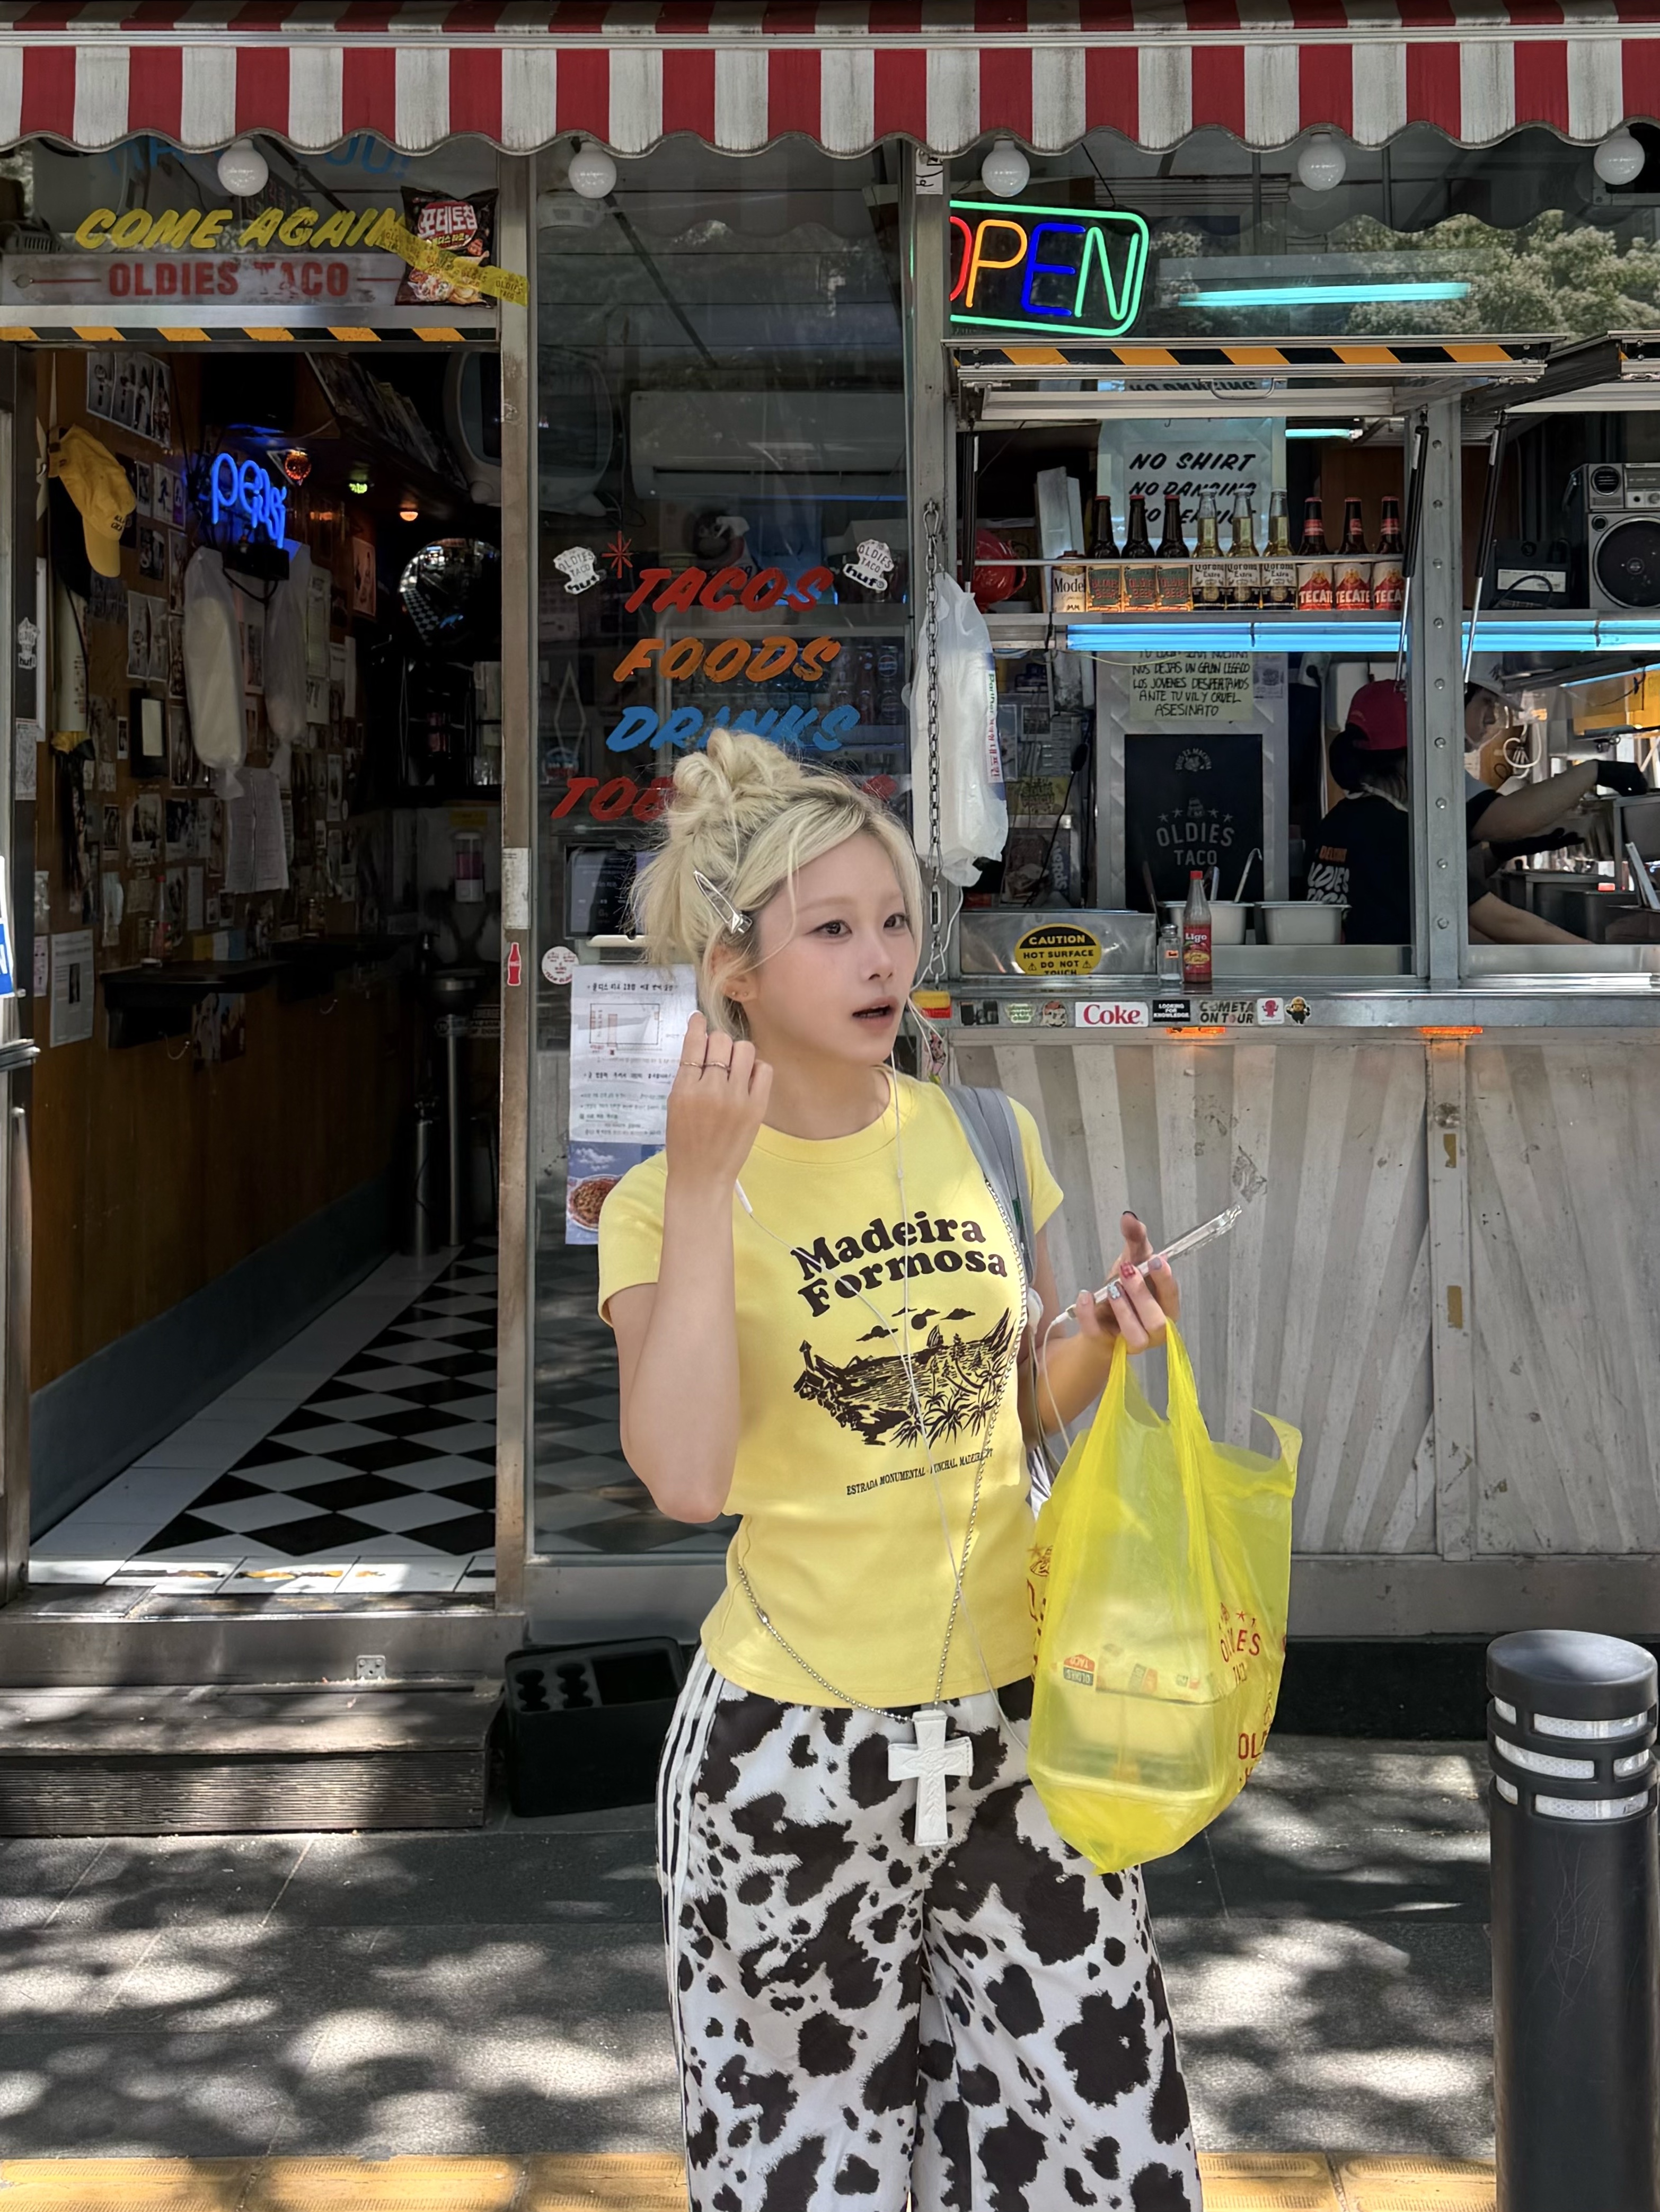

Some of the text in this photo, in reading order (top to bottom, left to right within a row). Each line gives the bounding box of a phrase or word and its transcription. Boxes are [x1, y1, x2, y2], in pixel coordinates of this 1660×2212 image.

[75, 208, 233, 250] COME
[239, 207, 406, 249] AGAIN
[417, 205, 478, 238] 포테토칩
[109, 261, 349, 297] OLDIES TACO
[496, 280, 523, 295] OLDIES
[1129, 452, 1256, 471] NO SHIRT
[1129, 481, 1257, 497] NO DANCING
[559, 552, 594, 571] OLDIES
[859, 544, 891, 568] OLDIES
[570, 564, 590, 577] TACO
[861, 558, 881, 573] TACO
[846, 565, 878, 587] huf
[625, 565, 835, 613] TACOS
[1336, 589, 1370, 604] TECATE
[1374, 589, 1403, 604] TECA
[613, 635, 841, 683] FOODS
[1133, 662, 1250, 675] NOS DEJAS UN GRAN LEGADO
[1133, 677, 1249, 691] LOS JOVENES DESPERTAMOS
[1140, 690, 1166, 701] ANTE
[1170, 691, 1182, 701] TU
[1186, 692, 1200, 701] VIL
[1200, 691, 1207, 702] Y
[1211, 692, 1241, 703] CRUEL
[1155, 704, 1218, 716] ASESINATO
[606, 705, 860, 752] DRINKS
[1156, 822, 1235, 847] OLDIES
[1173, 850, 1217, 866] TACO
[1029, 935, 1085, 945] CAUTION
[1185, 933, 1207, 943] Ligo
[1083, 1004, 1141, 1025] Coke
[1200, 1013, 1218, 1023] ON
[790, 1210, 986, 1280] Madeira
[798, 1250, 1008, 1317] Formosa
[847, 1479, 878, 1496] ESTRADA
[880, 1467, 925, 1484] MONUMENTAL
[1070, 1656, 1090, 1669] TACO
